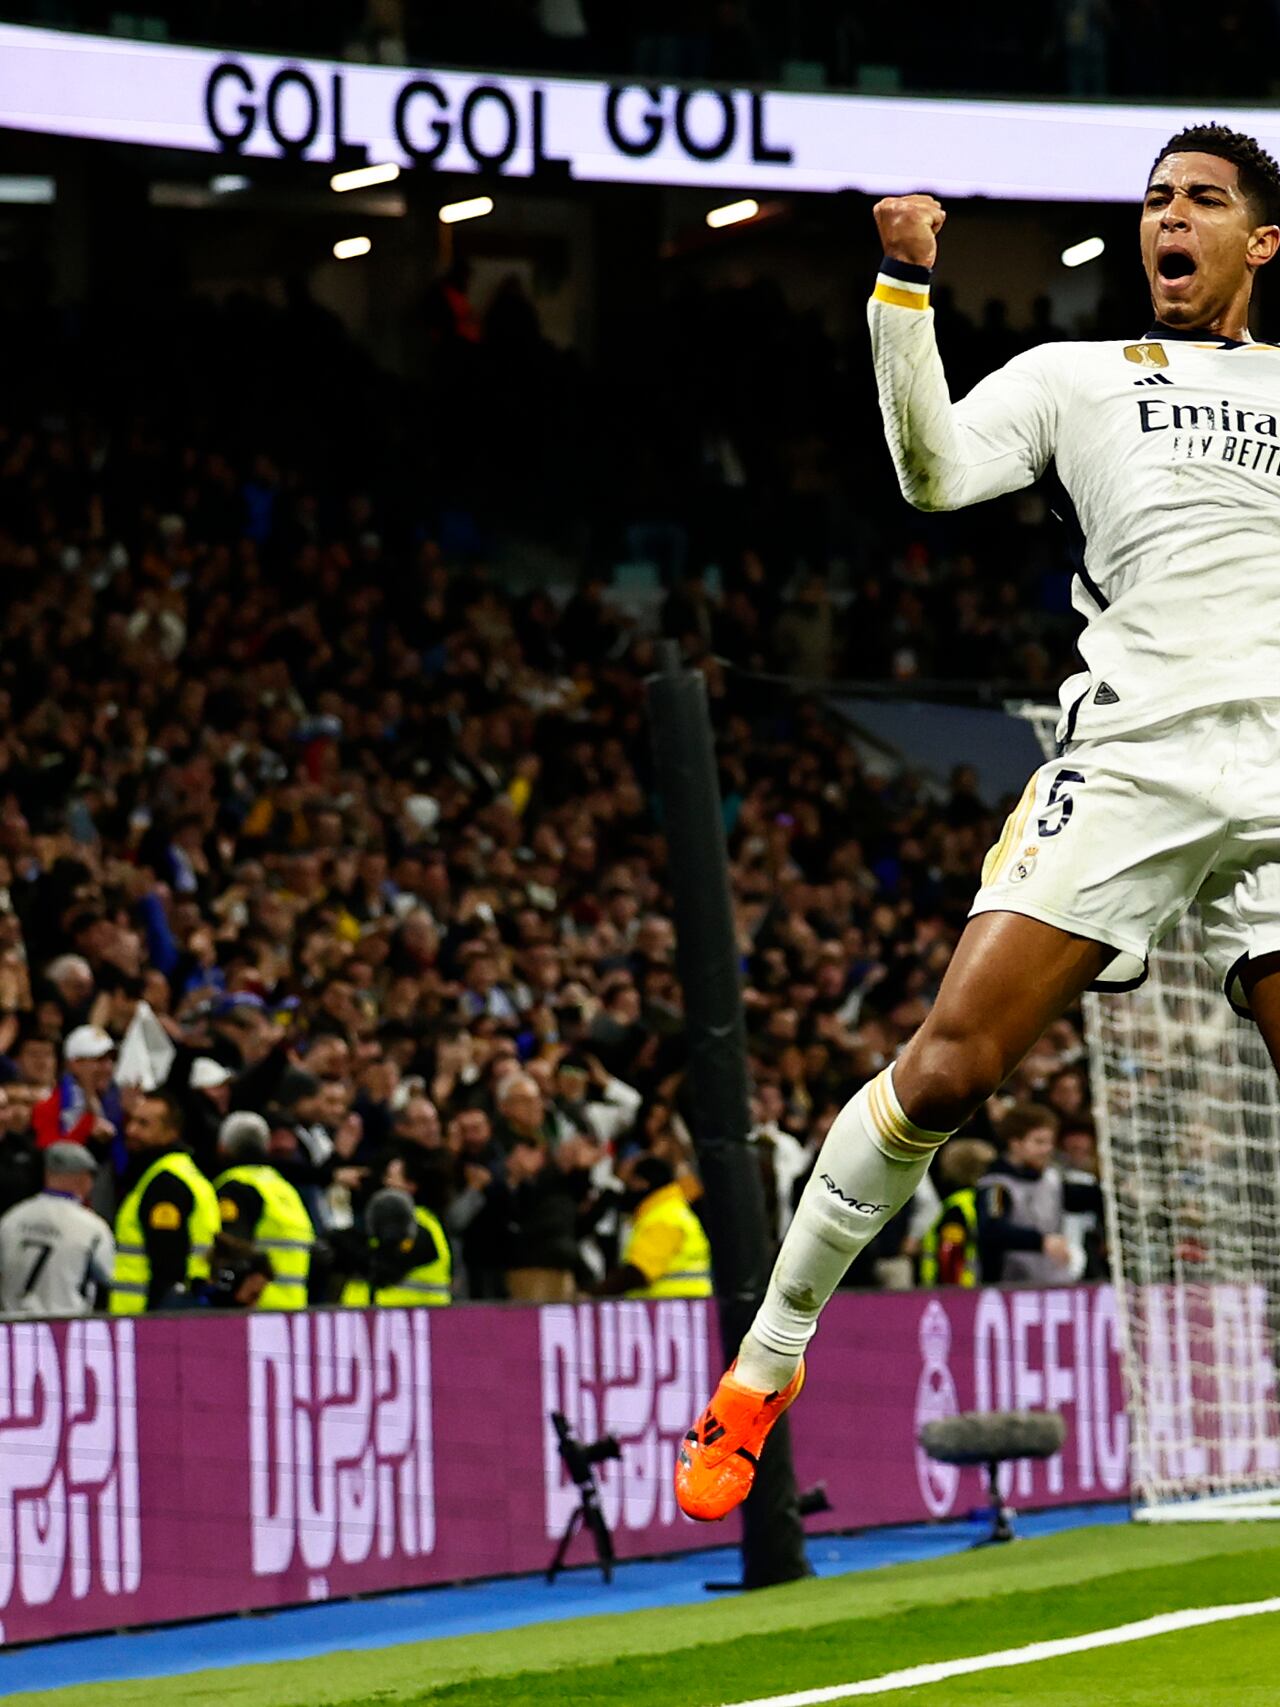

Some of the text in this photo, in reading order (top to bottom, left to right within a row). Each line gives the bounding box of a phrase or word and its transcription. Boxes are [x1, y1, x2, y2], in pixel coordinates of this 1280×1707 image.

[204, 62, 795, 179] GOL GOL GOL
[1038, 769, 1086, 837] 5
[18, 1239, 53, 1299] 7
[974, 1283, 1206, 1500] OFFICAL
